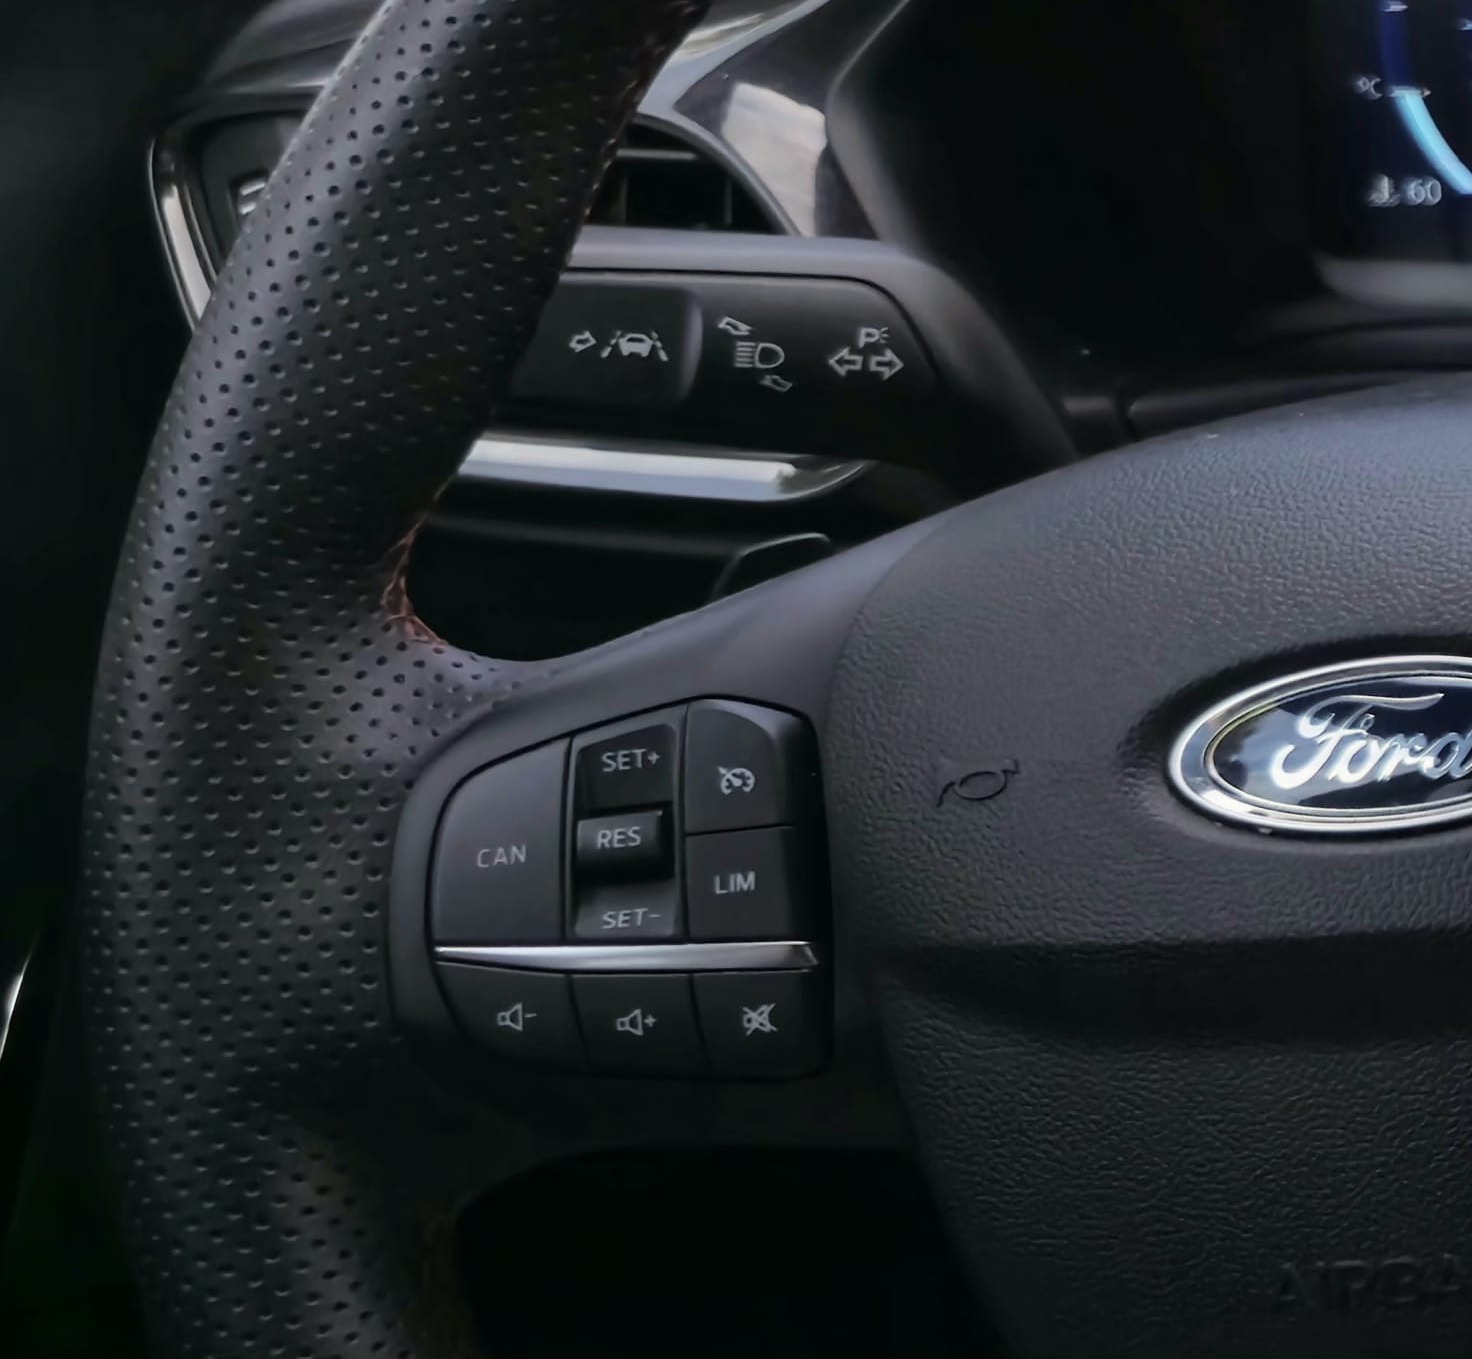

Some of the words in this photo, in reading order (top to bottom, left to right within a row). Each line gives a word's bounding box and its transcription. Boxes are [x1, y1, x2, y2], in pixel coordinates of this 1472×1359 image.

[1403, 178, 1441, 205] 60
[602, 749, 661, 773] SET+
[597, 826, 642, 849] RES
[476, 845, 527, 869] CAN
[714, 872, 756, 894] LIM
